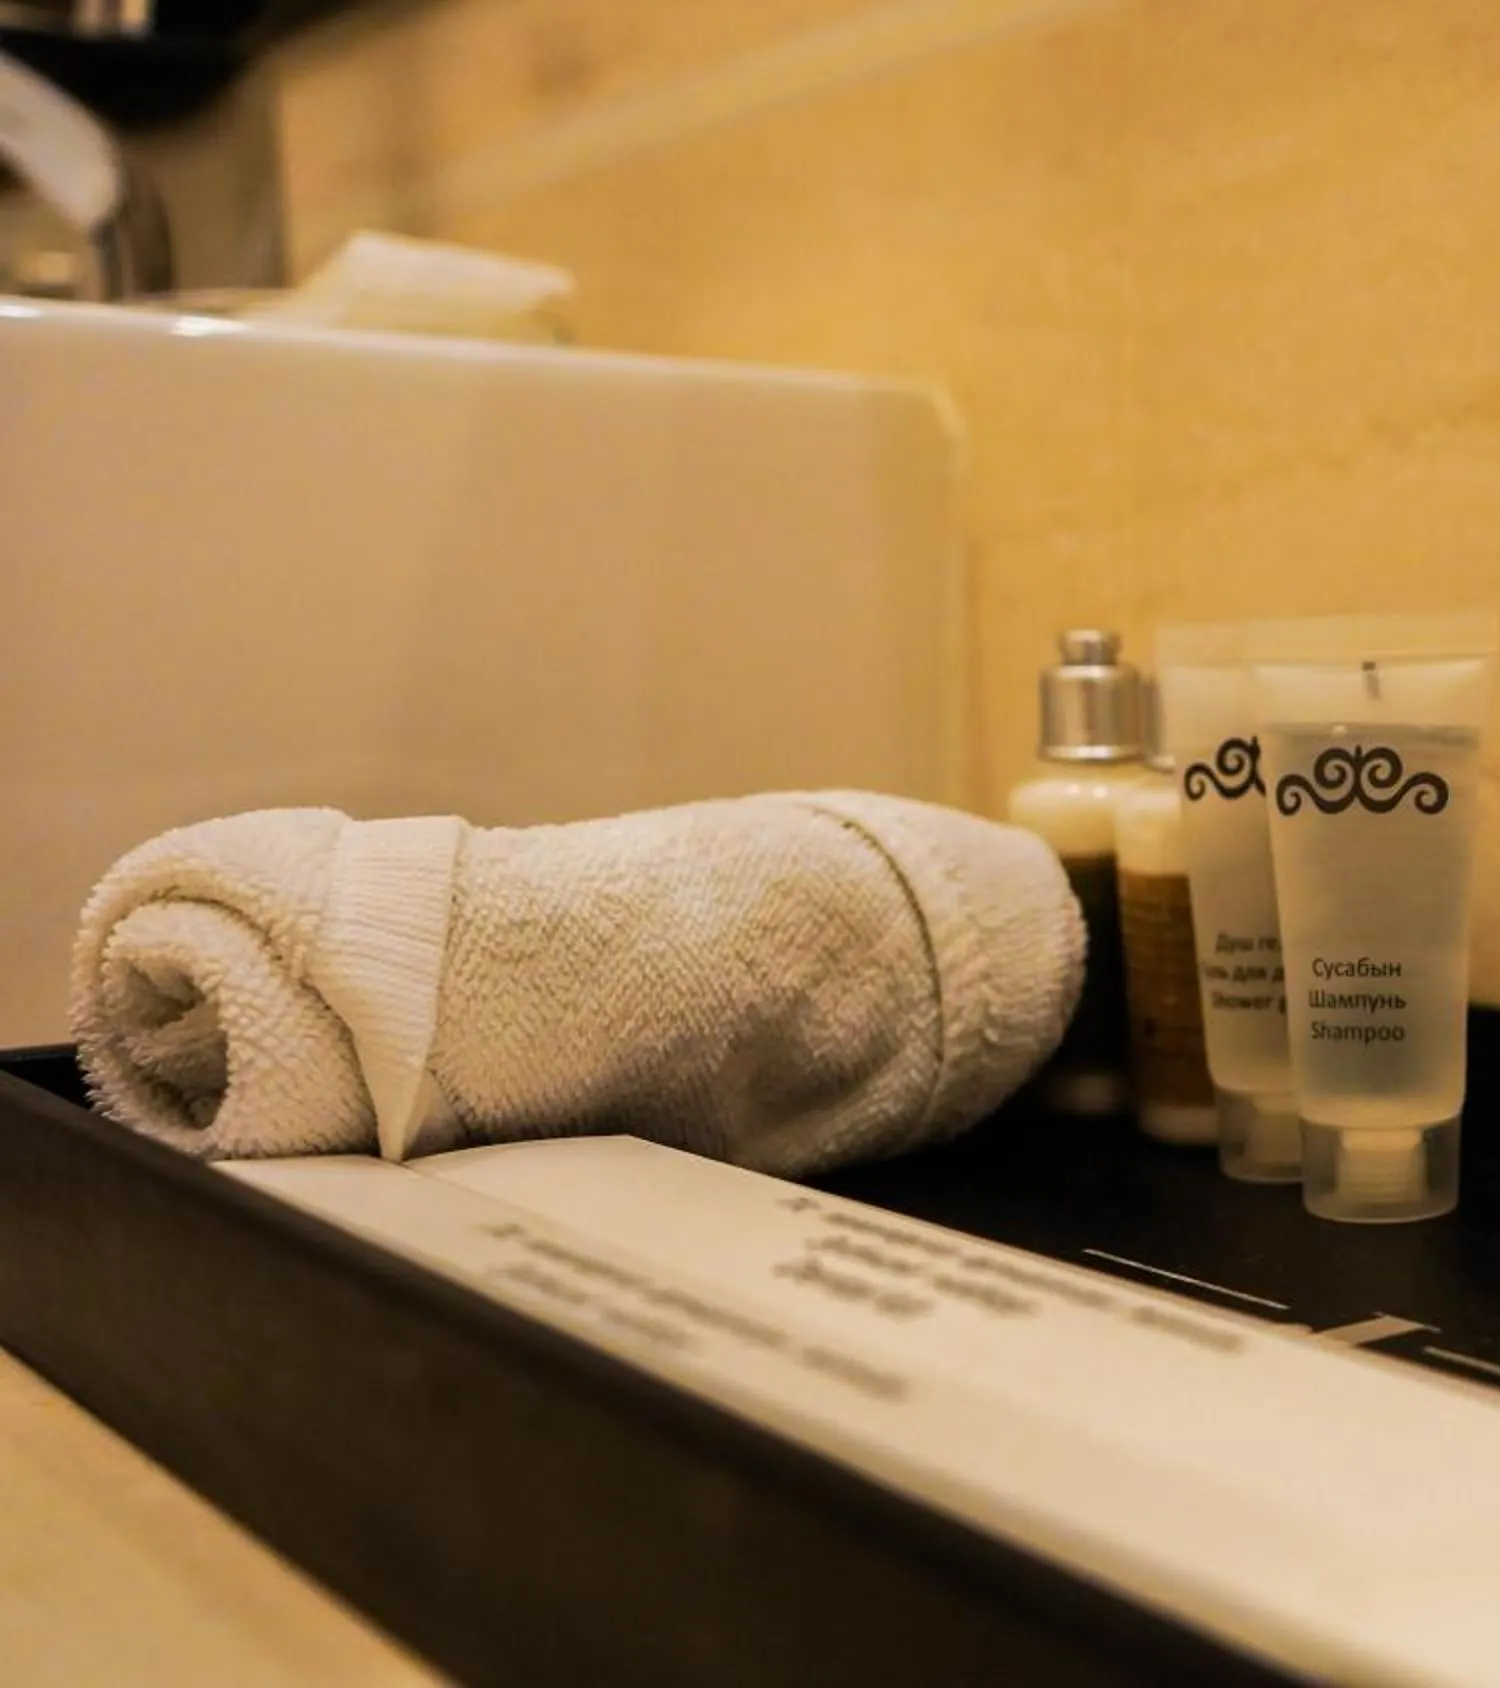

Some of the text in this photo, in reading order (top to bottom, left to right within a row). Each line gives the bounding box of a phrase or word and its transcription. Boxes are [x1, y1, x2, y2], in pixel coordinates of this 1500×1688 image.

[1311, 956, 1402, 981] Сусабын
[1308, 989, 1407, 1015] Шампунь
[1311, 1020, 1405, 1047] Shampoo
